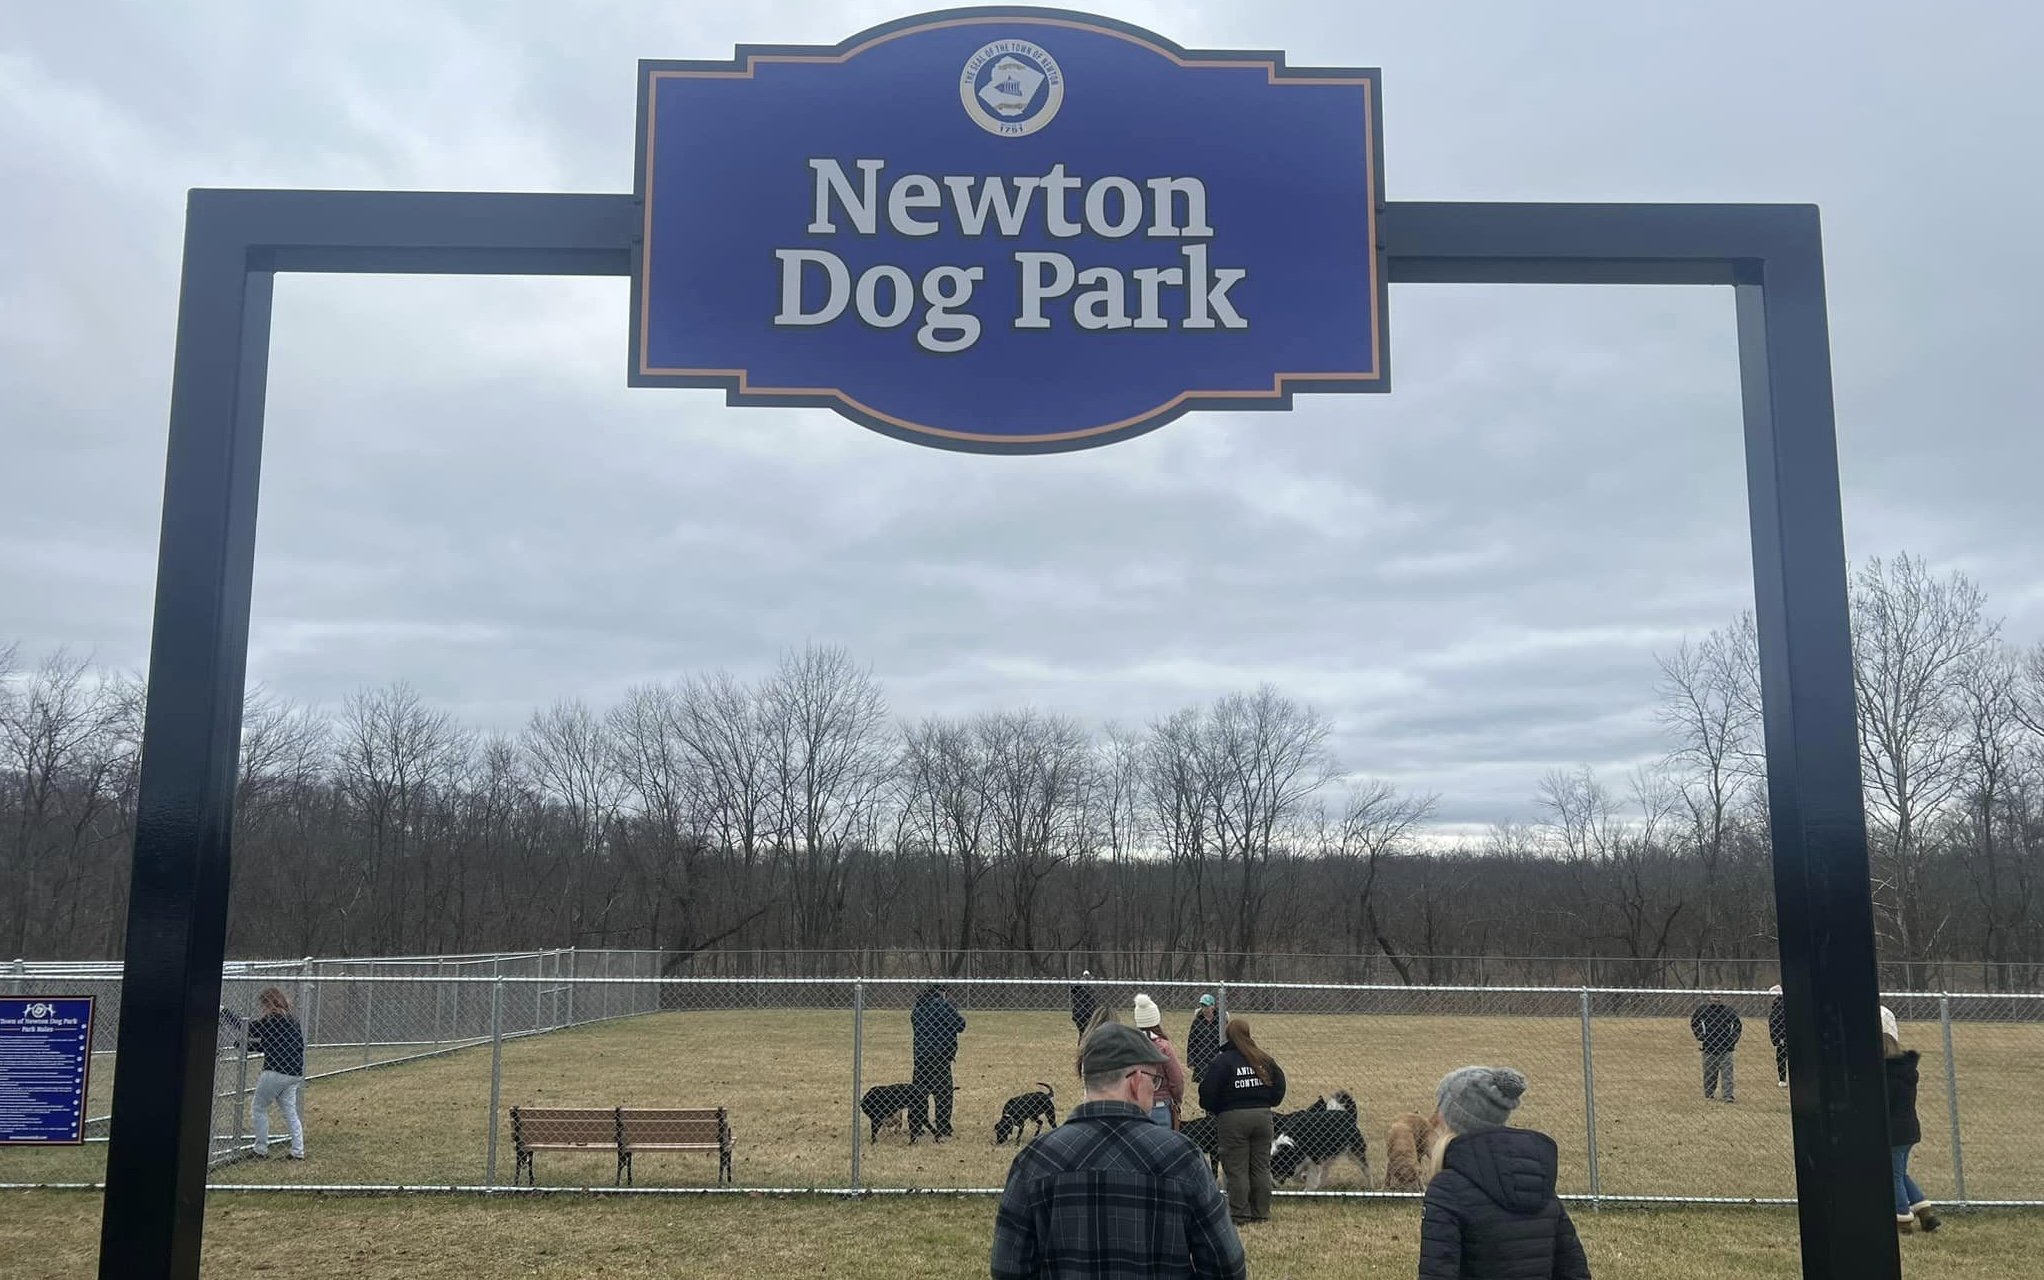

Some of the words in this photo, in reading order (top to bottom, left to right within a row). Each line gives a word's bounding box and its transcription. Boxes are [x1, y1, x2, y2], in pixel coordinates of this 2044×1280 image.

[807, 158, 1214, 237] Newton
[774, 249, 984, 353] Dog
[1014, 243, 1248, 329] Park
[50, 1018, 63, 1026] Dog
[1236, 1066, 1256, 1076] ANI
[1234, 1078, 1264, 1089] CONTR
